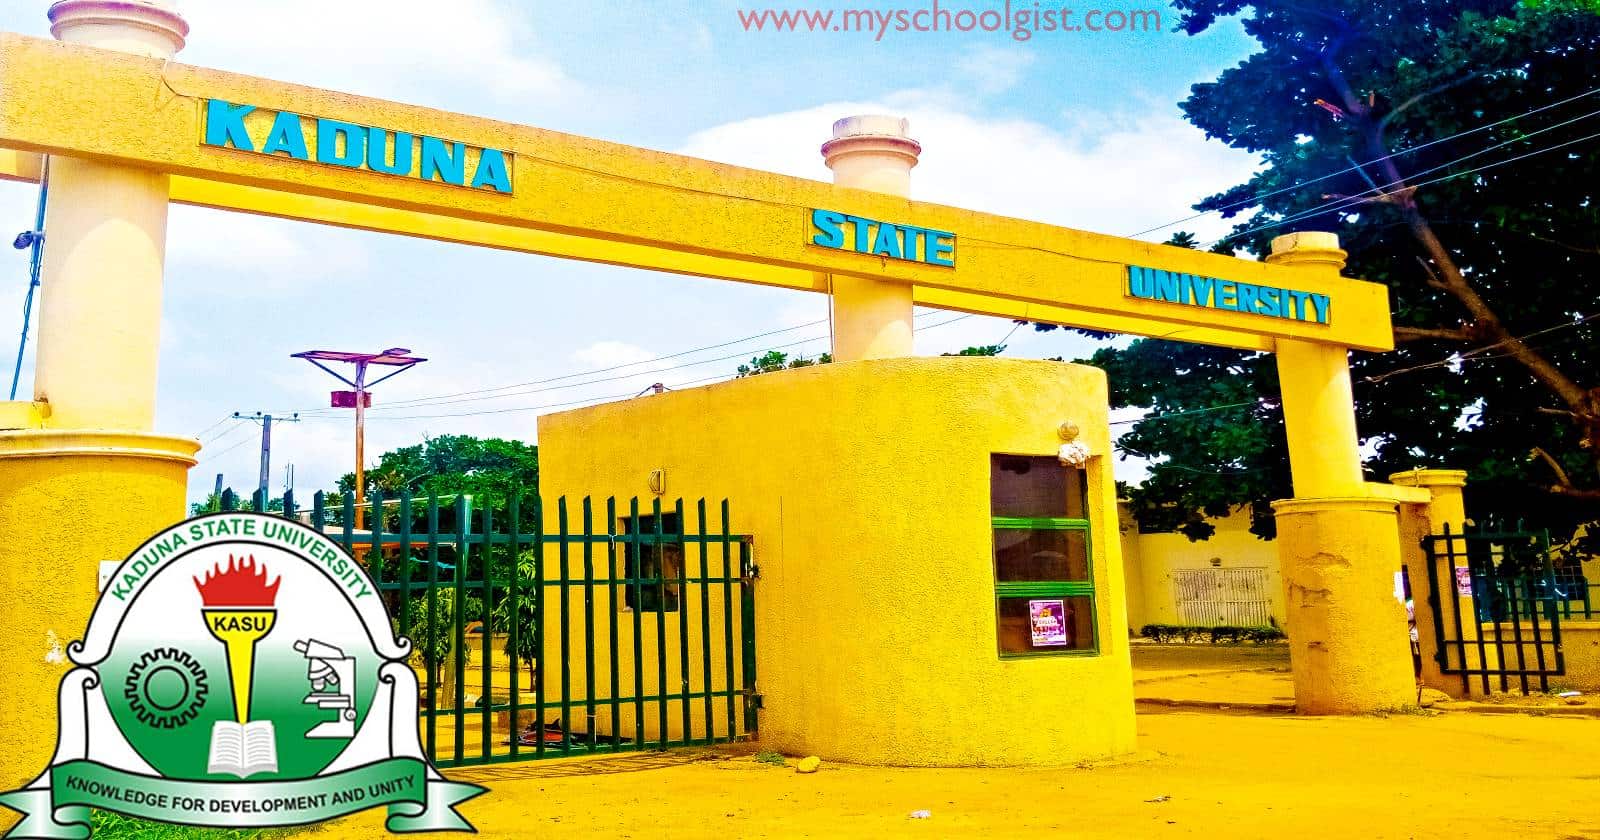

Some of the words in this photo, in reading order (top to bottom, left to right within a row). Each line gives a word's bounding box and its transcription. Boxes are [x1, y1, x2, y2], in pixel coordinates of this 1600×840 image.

[205, 98, 512, 194] KADUNA
[813, 209, 954, 267] STATE
[1128, 266, 1332, 325] UNIVERSITY
